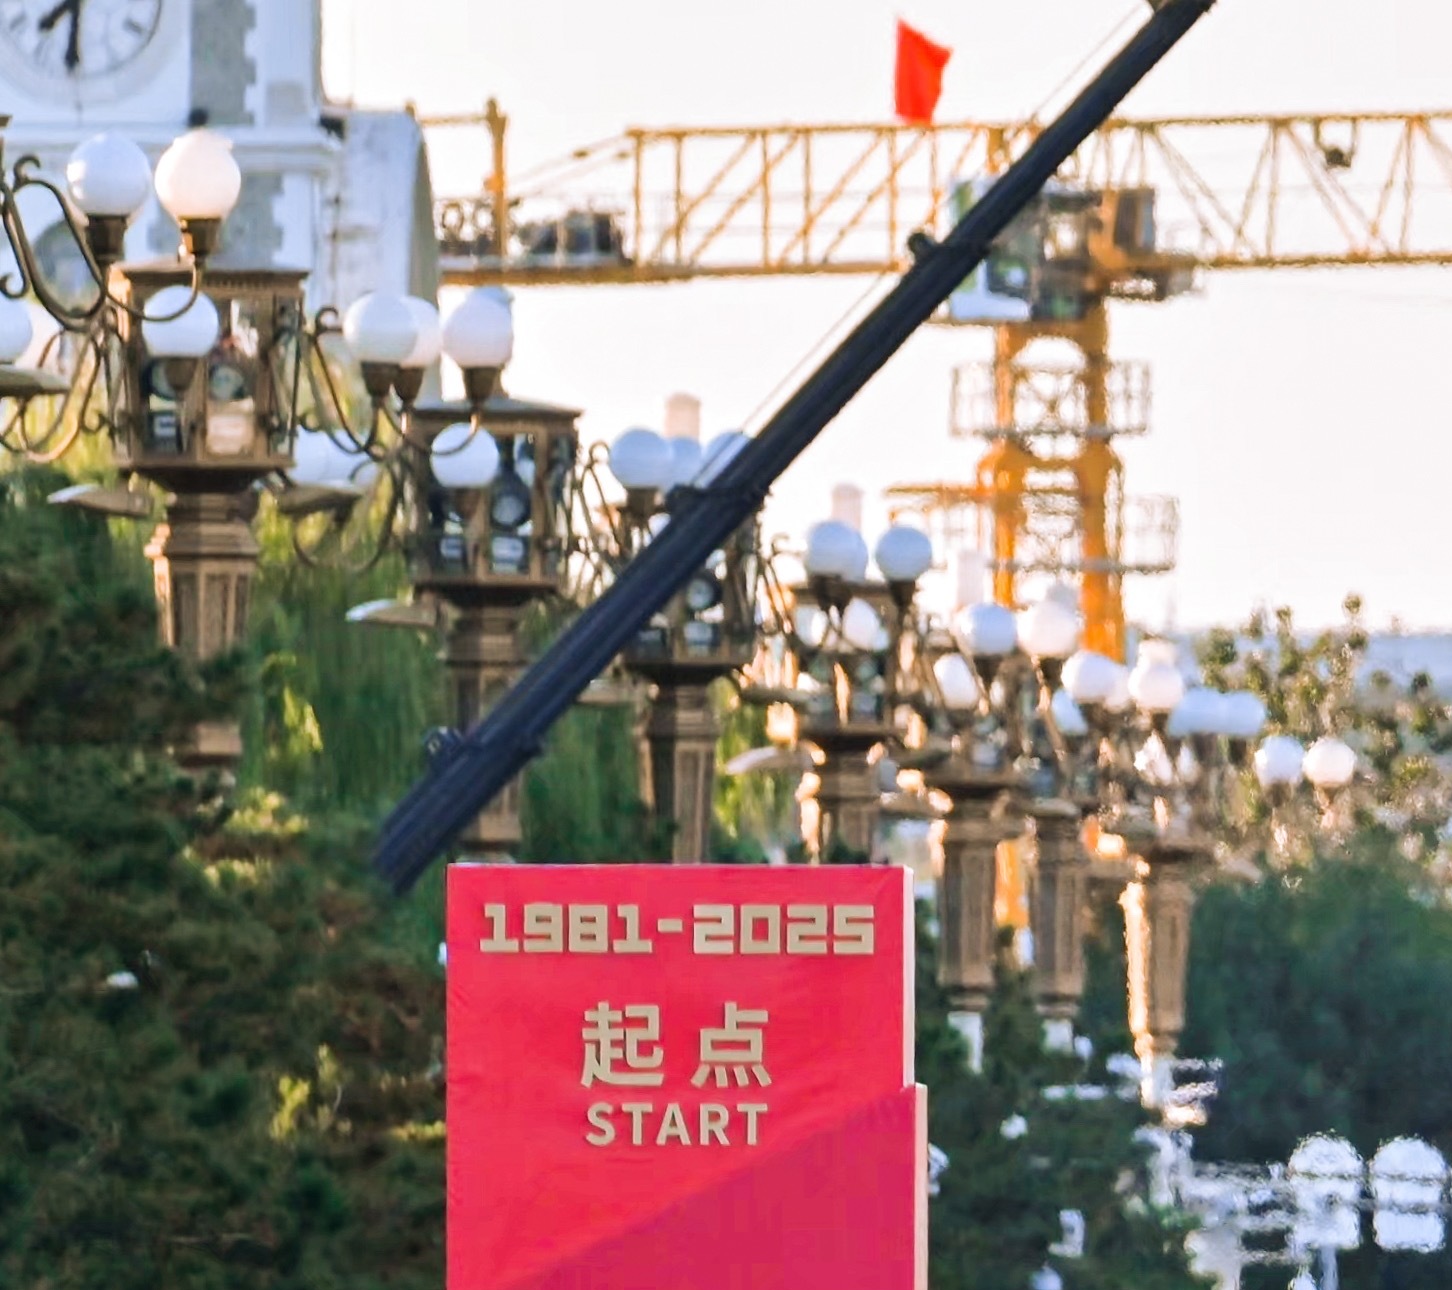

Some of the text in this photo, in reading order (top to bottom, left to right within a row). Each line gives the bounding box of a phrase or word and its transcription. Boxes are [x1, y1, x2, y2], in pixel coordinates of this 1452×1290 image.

[480, 902, 875, 956] 1981-2025
[580, 1001, 773, 1089] 起点
[585, 1101, 769, 1146] START
